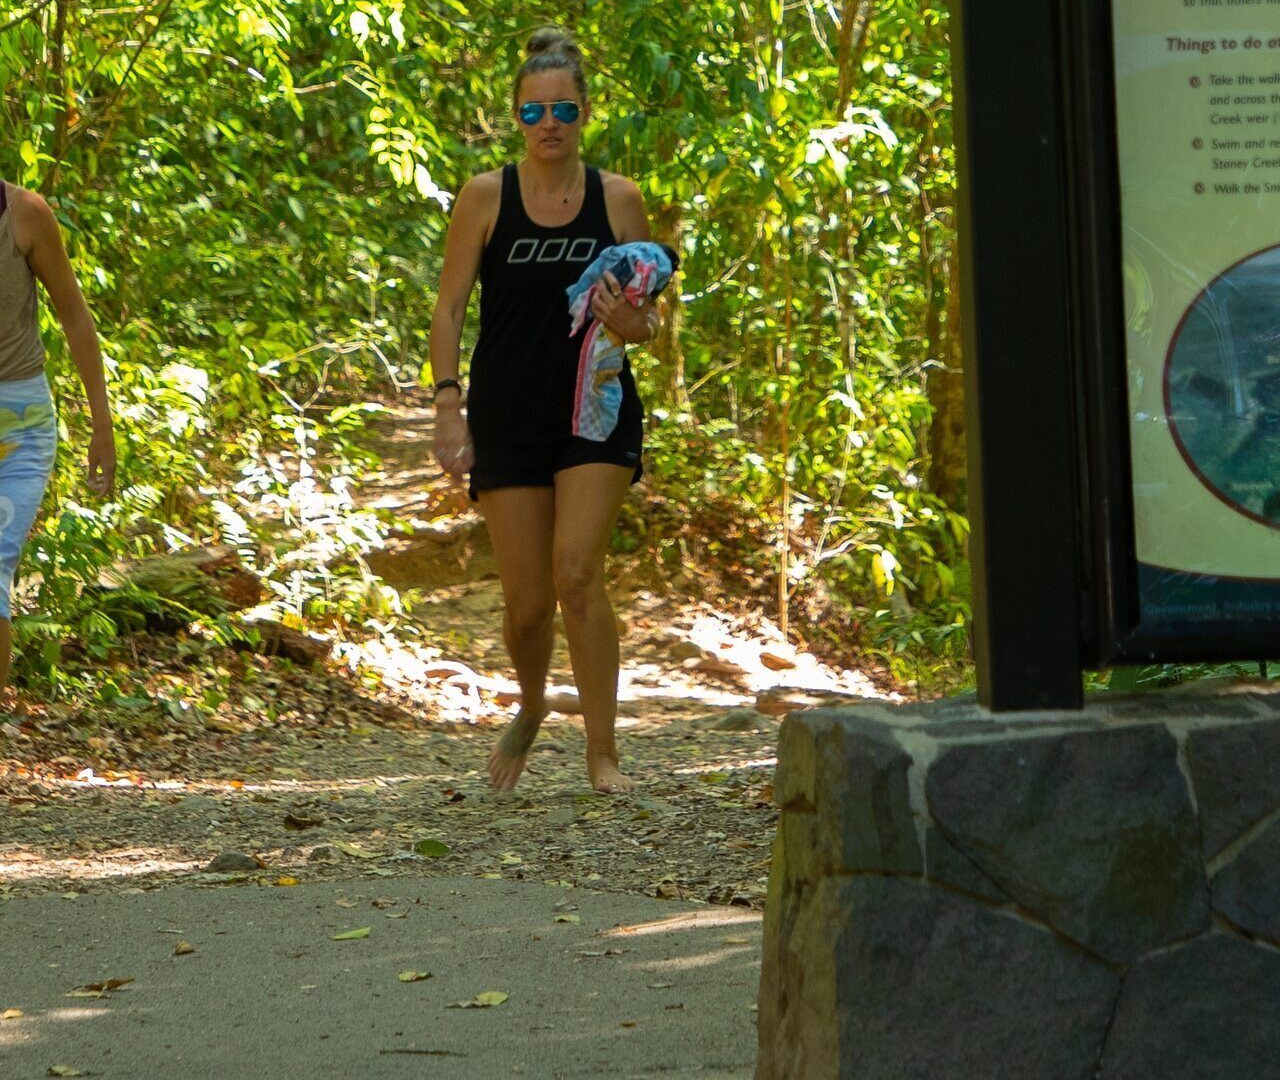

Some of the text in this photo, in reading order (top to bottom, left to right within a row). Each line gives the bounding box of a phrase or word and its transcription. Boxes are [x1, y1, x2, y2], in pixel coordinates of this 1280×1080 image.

[1182, 0, 1196, 7] so
[1165, 37, 1217, 55] Things
[1220, 37, 1238, 49] to
[1243, 35, 1262, 49] do
[1209, 74, 1234, 86] Take
[1237, 74, 1255, 85] the
[1209, 94, 1231, 105] and
[1233, 97, 1267, 105] across
[1210, 113, 1243, 125] Creek
[1246, 113, 1269, 124] weir
[1211, 138, 1241, 150] Swim
[1244, 138, 1266, 149] and
[1212, 158, 1249, 173] Stoney
[1213, 182, 1241, 194] Walk
[1243, 182, 1261, 193] the
